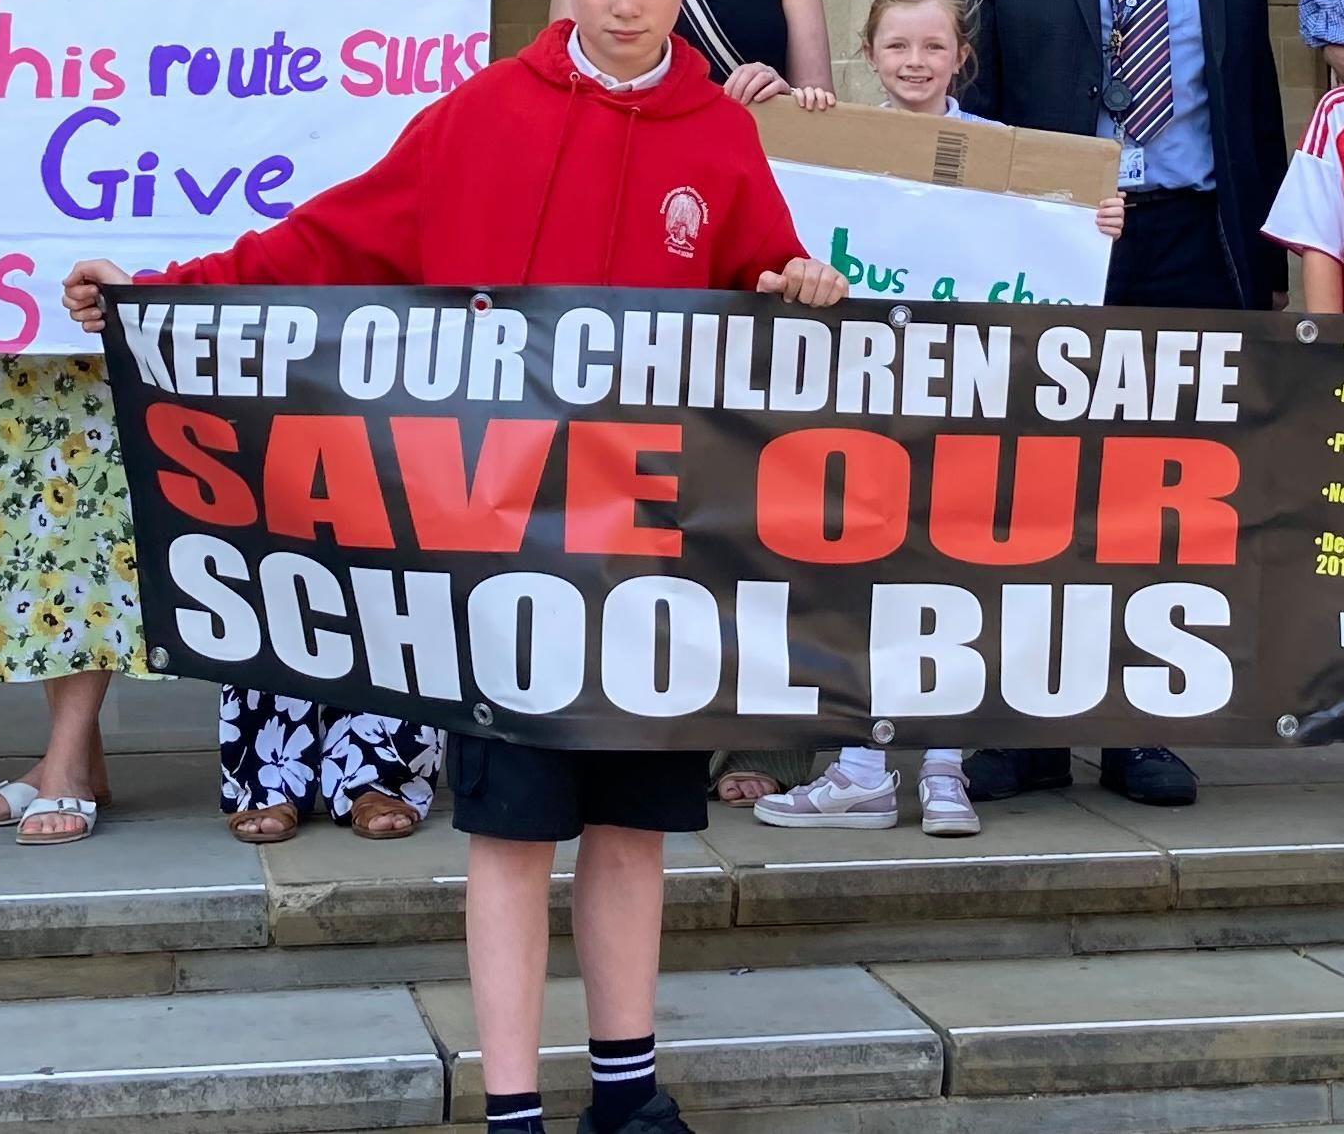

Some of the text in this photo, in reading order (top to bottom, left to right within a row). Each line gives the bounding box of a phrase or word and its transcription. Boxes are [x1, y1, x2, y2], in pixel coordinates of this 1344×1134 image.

[148, 31, 328, 99] route
[40, 106, 294, 222] Give
[830, 227, 909, 293] bus
[932, 277, 959, 302] a
[116, 303, 1244, 423] KEEP OUR CHILDREN SAFE
[144, 403, 1241, 567] SAVE OUR
[168, 533, 1234, 718] SCHOOL BUS
